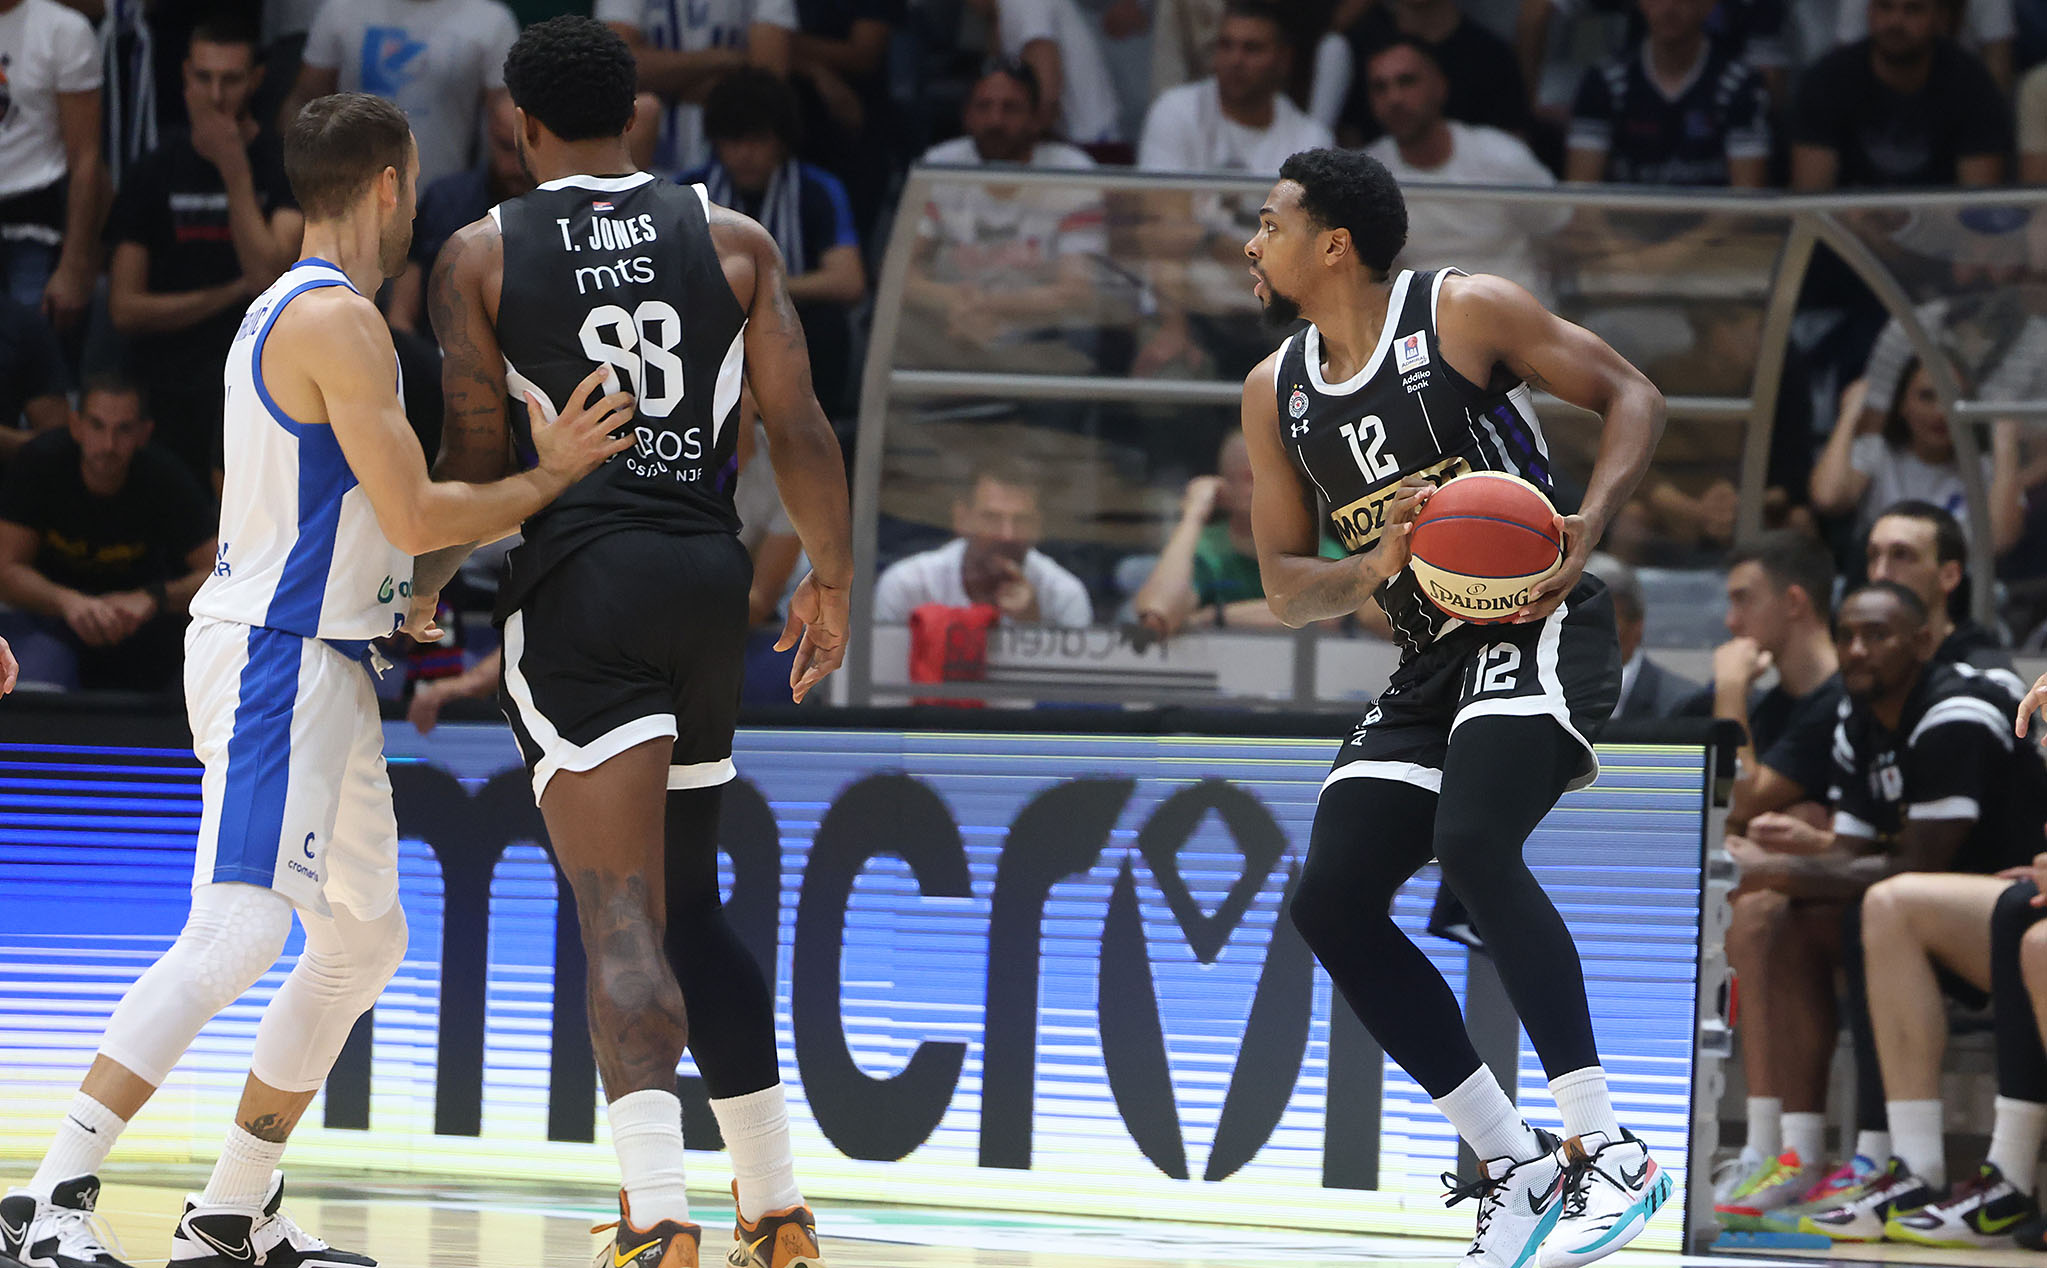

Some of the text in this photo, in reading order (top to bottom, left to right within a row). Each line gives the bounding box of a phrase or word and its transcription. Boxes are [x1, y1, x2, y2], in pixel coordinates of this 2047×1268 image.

[556, 213, 658, 252] T. JONES
[575, 256, 655, 295] mts
[577, 300, 686, 418] 88
[1402, 370, 1431, 387] Addiko
[1406, 379, 1430, 394] Bank
[1338, 414, 1401, 485] 12
[1429, 579, 1529, 611] SPALDING
[1472, 641, 1521, 697] 12
